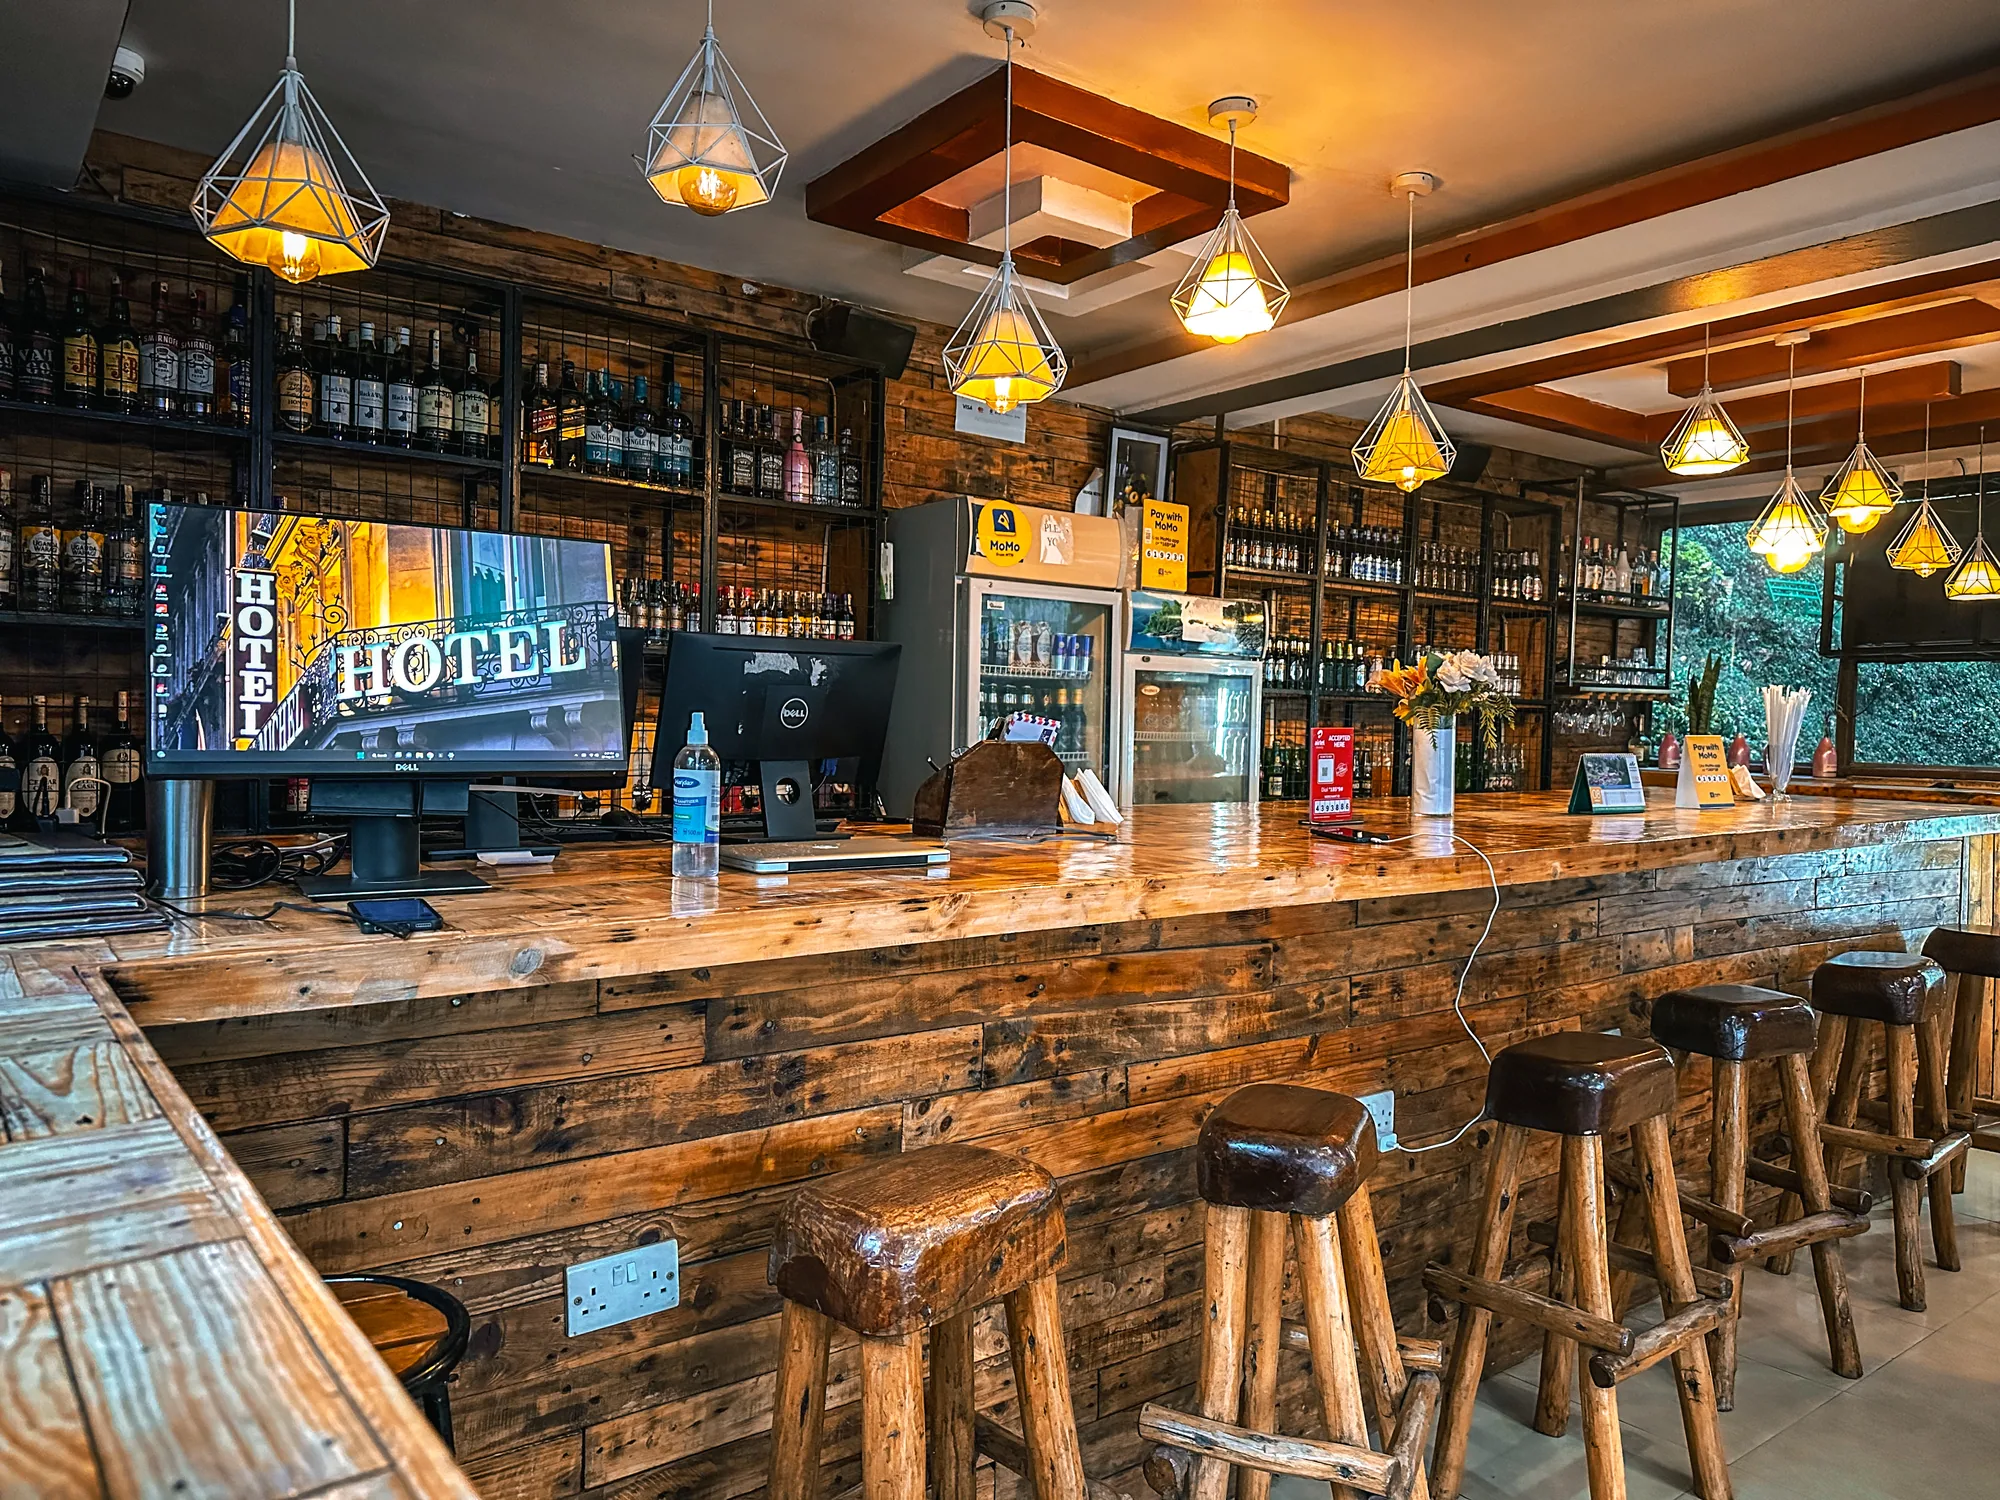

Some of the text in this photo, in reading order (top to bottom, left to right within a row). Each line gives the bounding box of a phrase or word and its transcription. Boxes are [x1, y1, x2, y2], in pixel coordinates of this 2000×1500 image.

[19, 349, 53, 362] VAT
[962, 403, 973, 411] VISA
[590, 431, 621, 444] SINGETON
[592, 450, 602, 459] 12
[663, 460, 672, 469] 15
[1151, 508, 1183, 523] Pay with
[1155, 520, 1178, 533] MoMo
[990, 540, 1020, 552] MoMo
[1146, 550, 1183, 563] 619231
[336, 619, 588, 700] HOTEL
[784, 709, 805, 718] DELL
[1328, 734, 1351, 742] ACCEPTED
[1693, 743, 1704, 751] Pay
[395, 763, 419, 772] DELL
